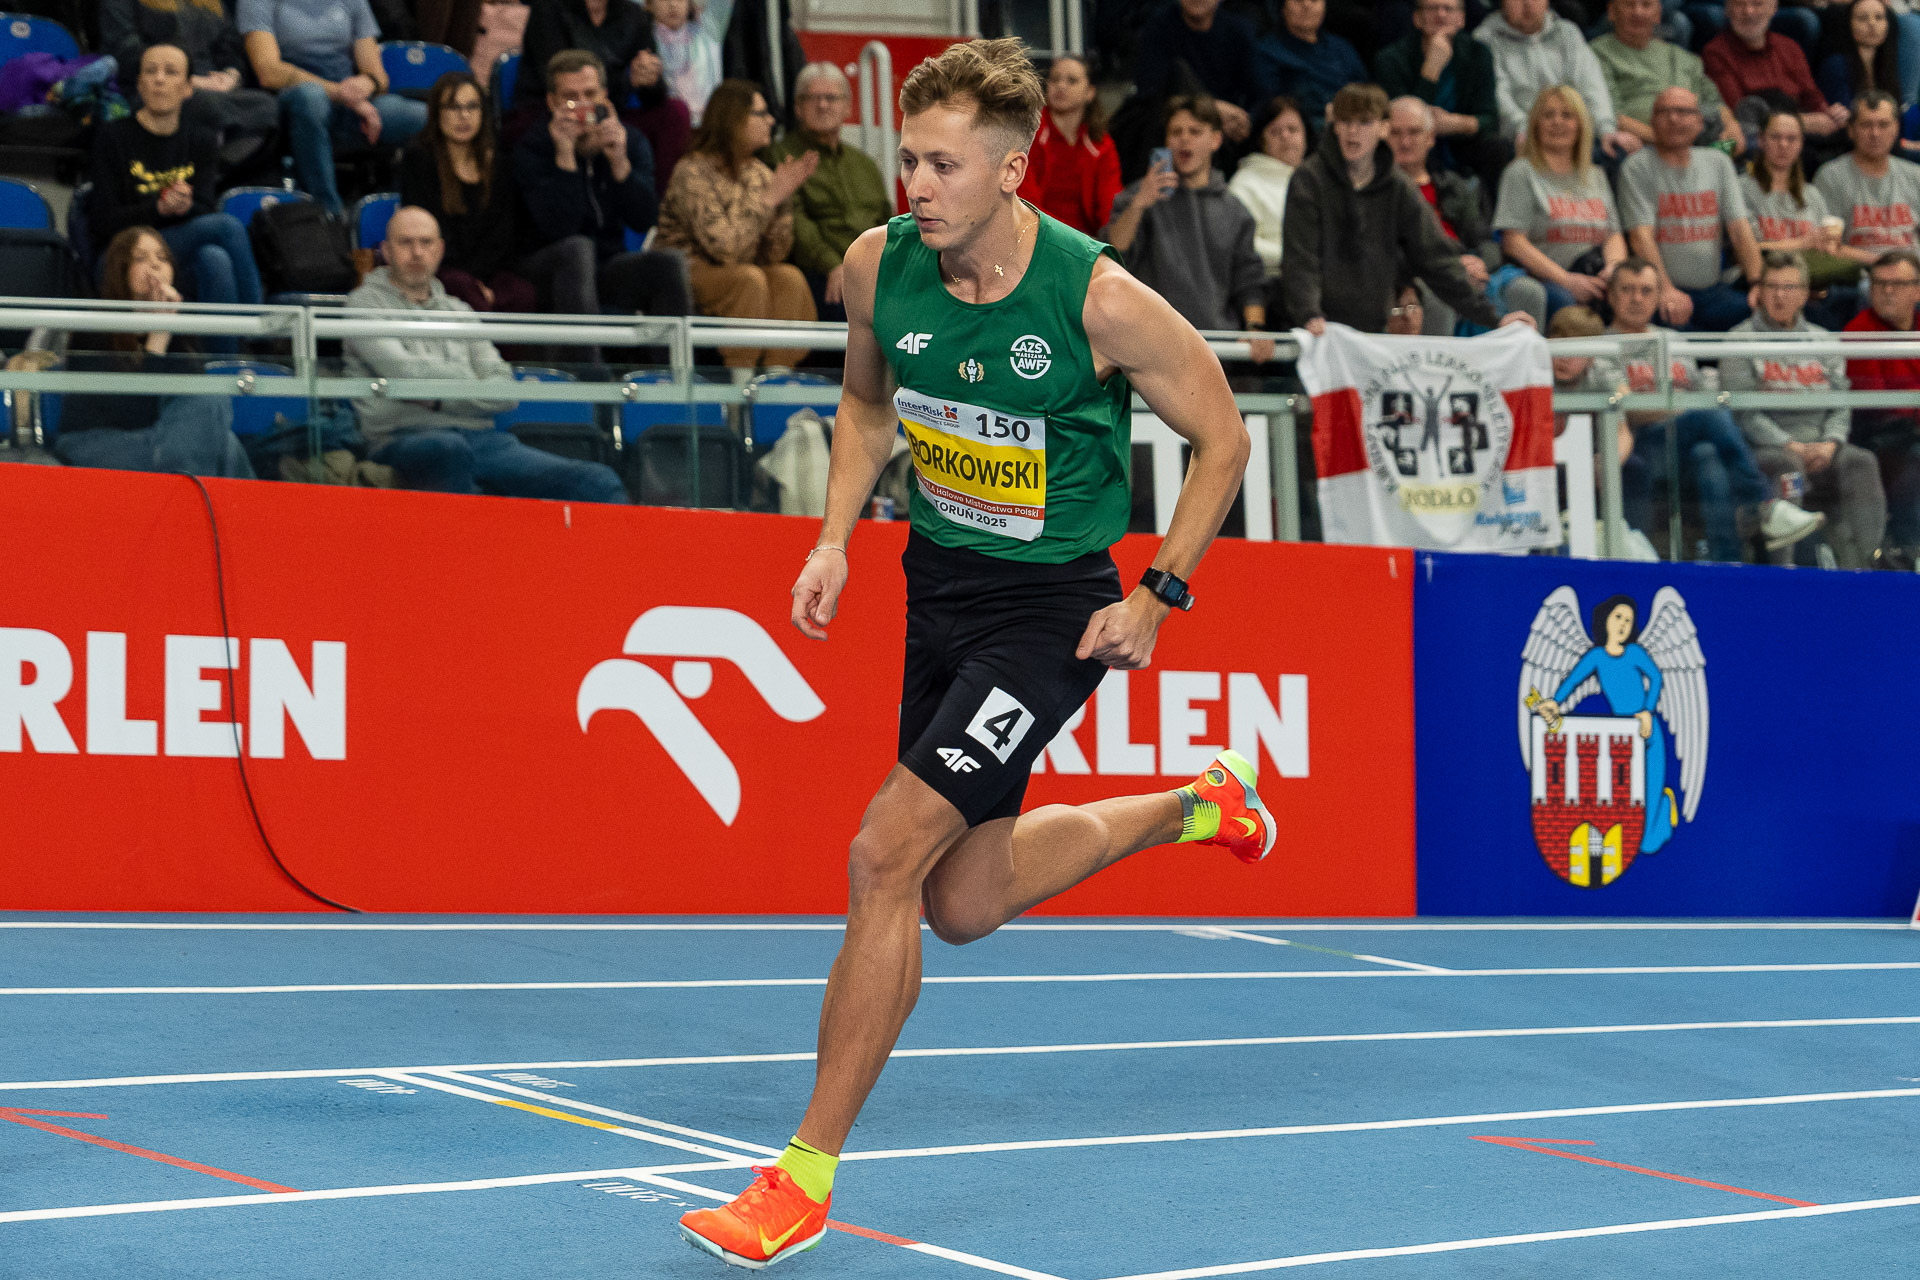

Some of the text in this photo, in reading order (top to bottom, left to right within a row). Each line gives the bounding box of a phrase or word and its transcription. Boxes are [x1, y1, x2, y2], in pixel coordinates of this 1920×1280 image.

[896, 332, 933, 354] 4F
[1015, 352, 1047, 360] WARSZAWA
[1019, 341, 1043, 354] AZS
[1017, 359, 1046, 371] AWF
[897, 397, 944, 418] InterRisk
[976, 413, 1031, 442] 150
[908, 431, 1039, 490] BORKOWSKI
[933, 498, 1007, 528] TORUŃ 2025
[936, 487, 964, 503] Halowe
[965, 497, 1013, 514] Mistrzostwa
[1015, 506, 1039, 518] Polski
[982, 707, 1024, 751] 4
[936, 747, 982, 773] 4F
